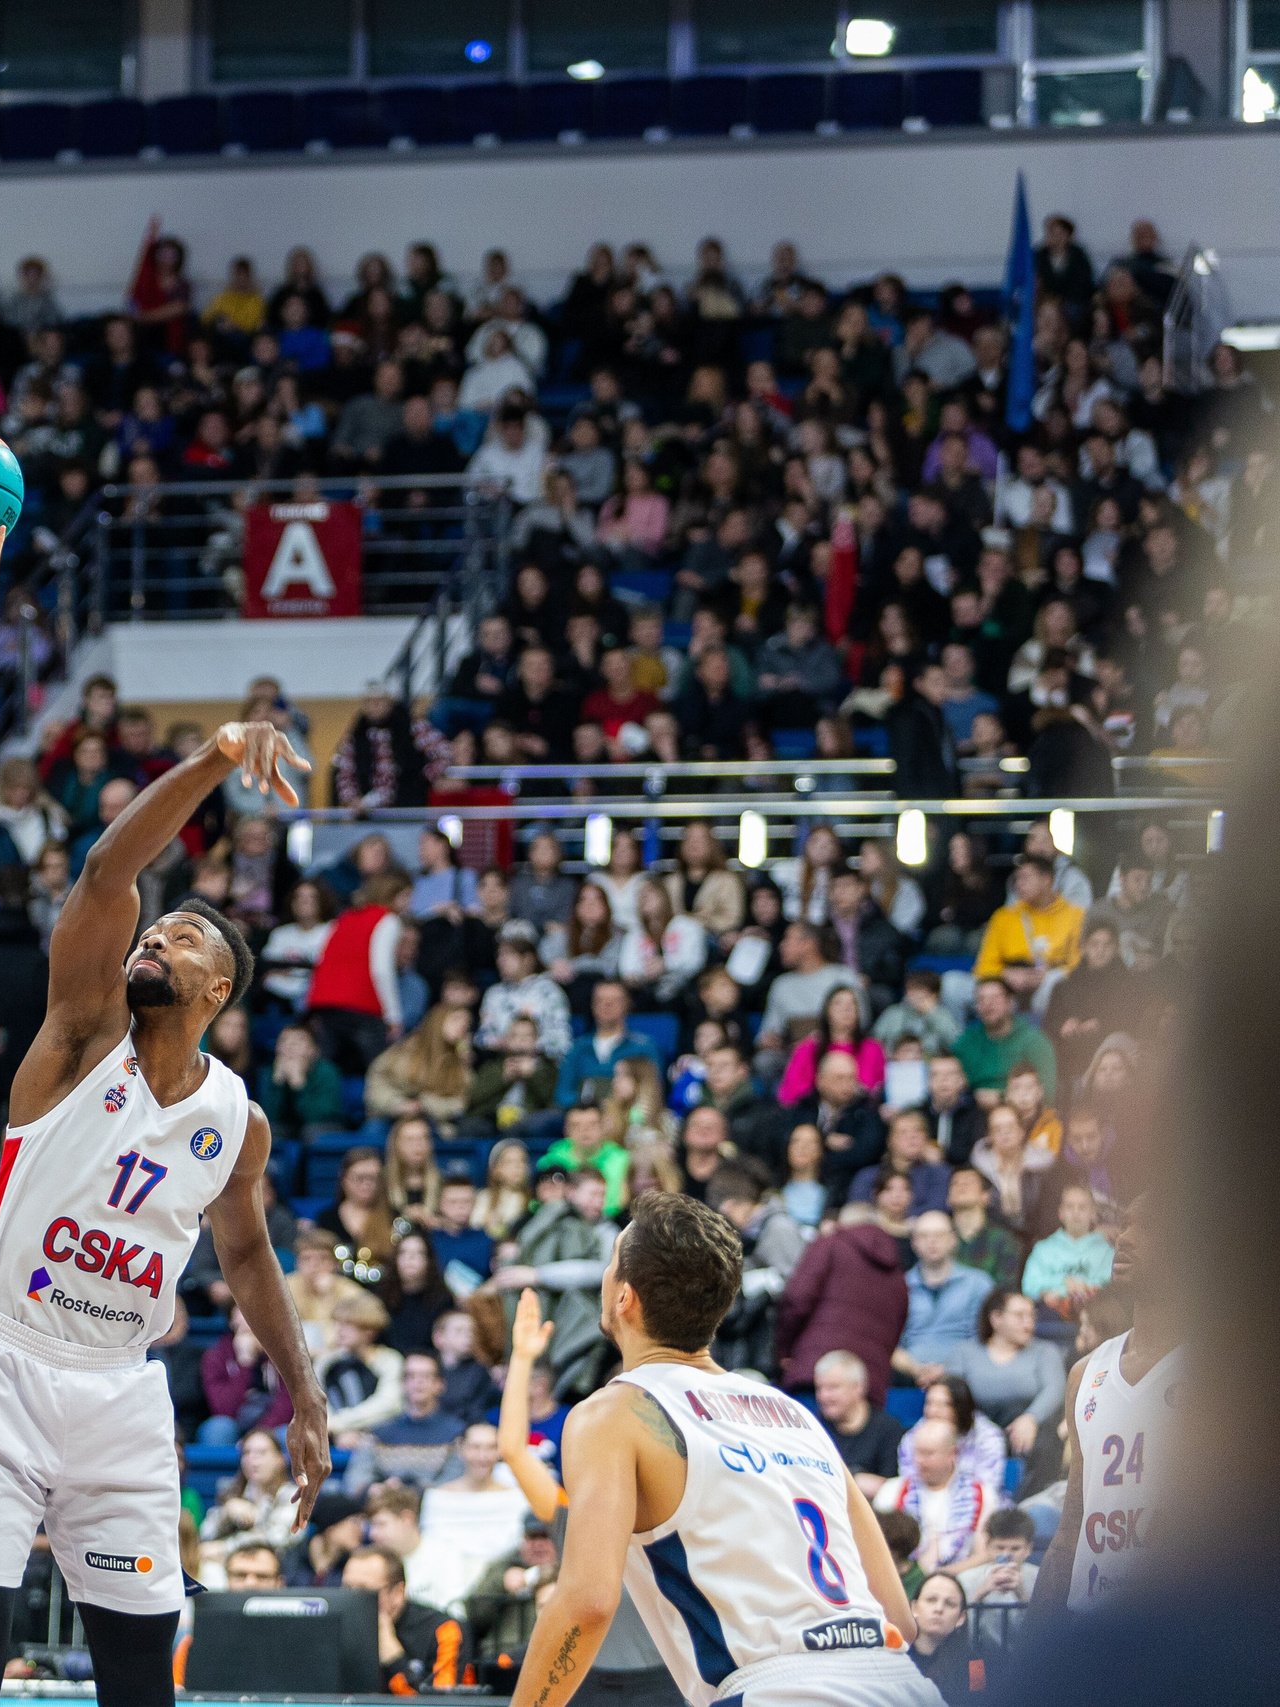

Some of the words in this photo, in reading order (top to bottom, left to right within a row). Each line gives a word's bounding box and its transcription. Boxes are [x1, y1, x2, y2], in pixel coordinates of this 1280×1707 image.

[260, 522, 336, 598] A
[107, 1090, 125, 1106] CSKA
[107, 1150, 168, 1215] 17
[42, 1216, 163, 1299] CSKA
[50, 1288, 146, 1330] Rostelecom
[1101, 1432, 1145, 1487] 24
[793, 1497, 850, 1605] 8
[1085, 1507, 1150, 1554] CSK
[88, 1554, 132, 1571] Winline
